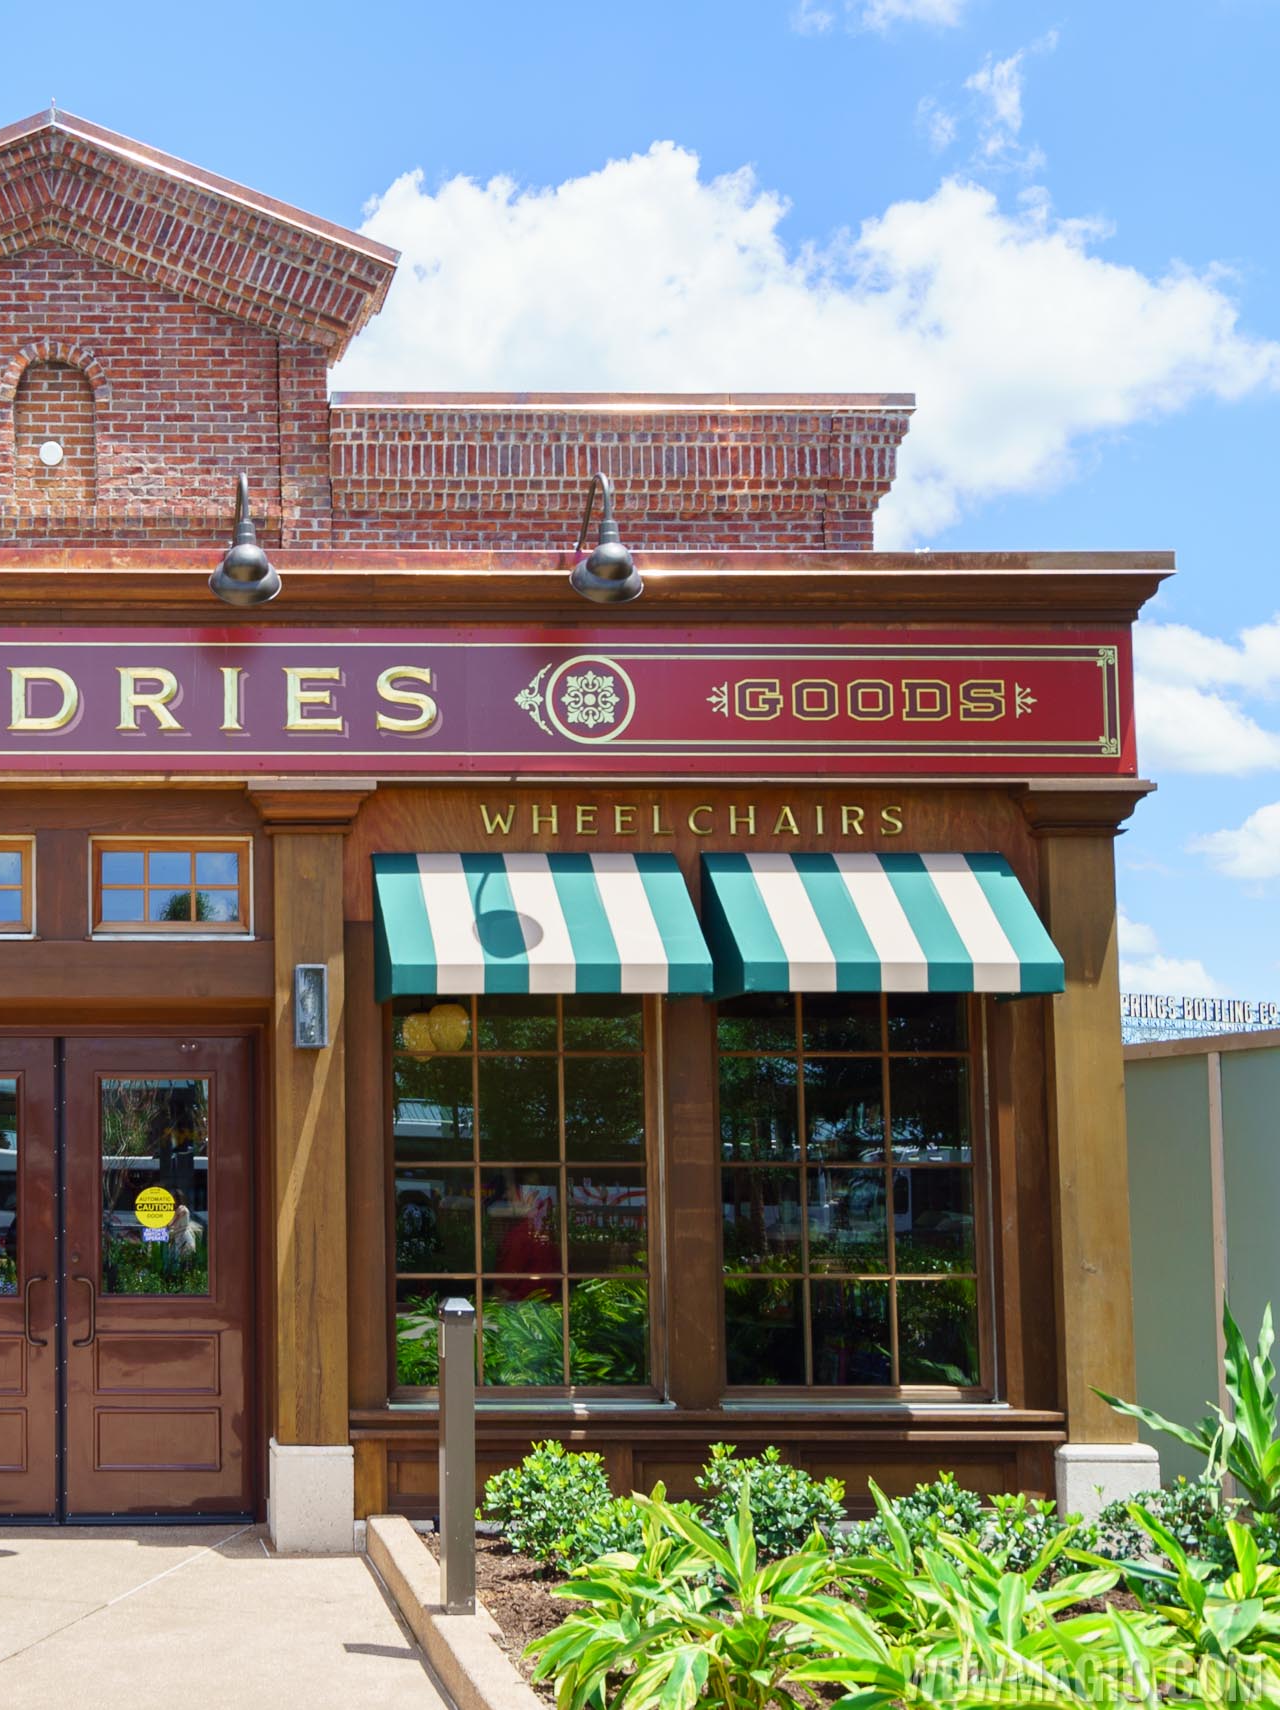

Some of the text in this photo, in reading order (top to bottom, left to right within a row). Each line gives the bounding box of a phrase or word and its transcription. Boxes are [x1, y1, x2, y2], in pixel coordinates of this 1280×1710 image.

[734, 678, 1007, 722] GOODS
[480, 804, 905, 837] WHEELCHAIRS
[1182, 996, 1254, 1024] BOTTLING
[136, 1203, 174, 1211] CAUTION
